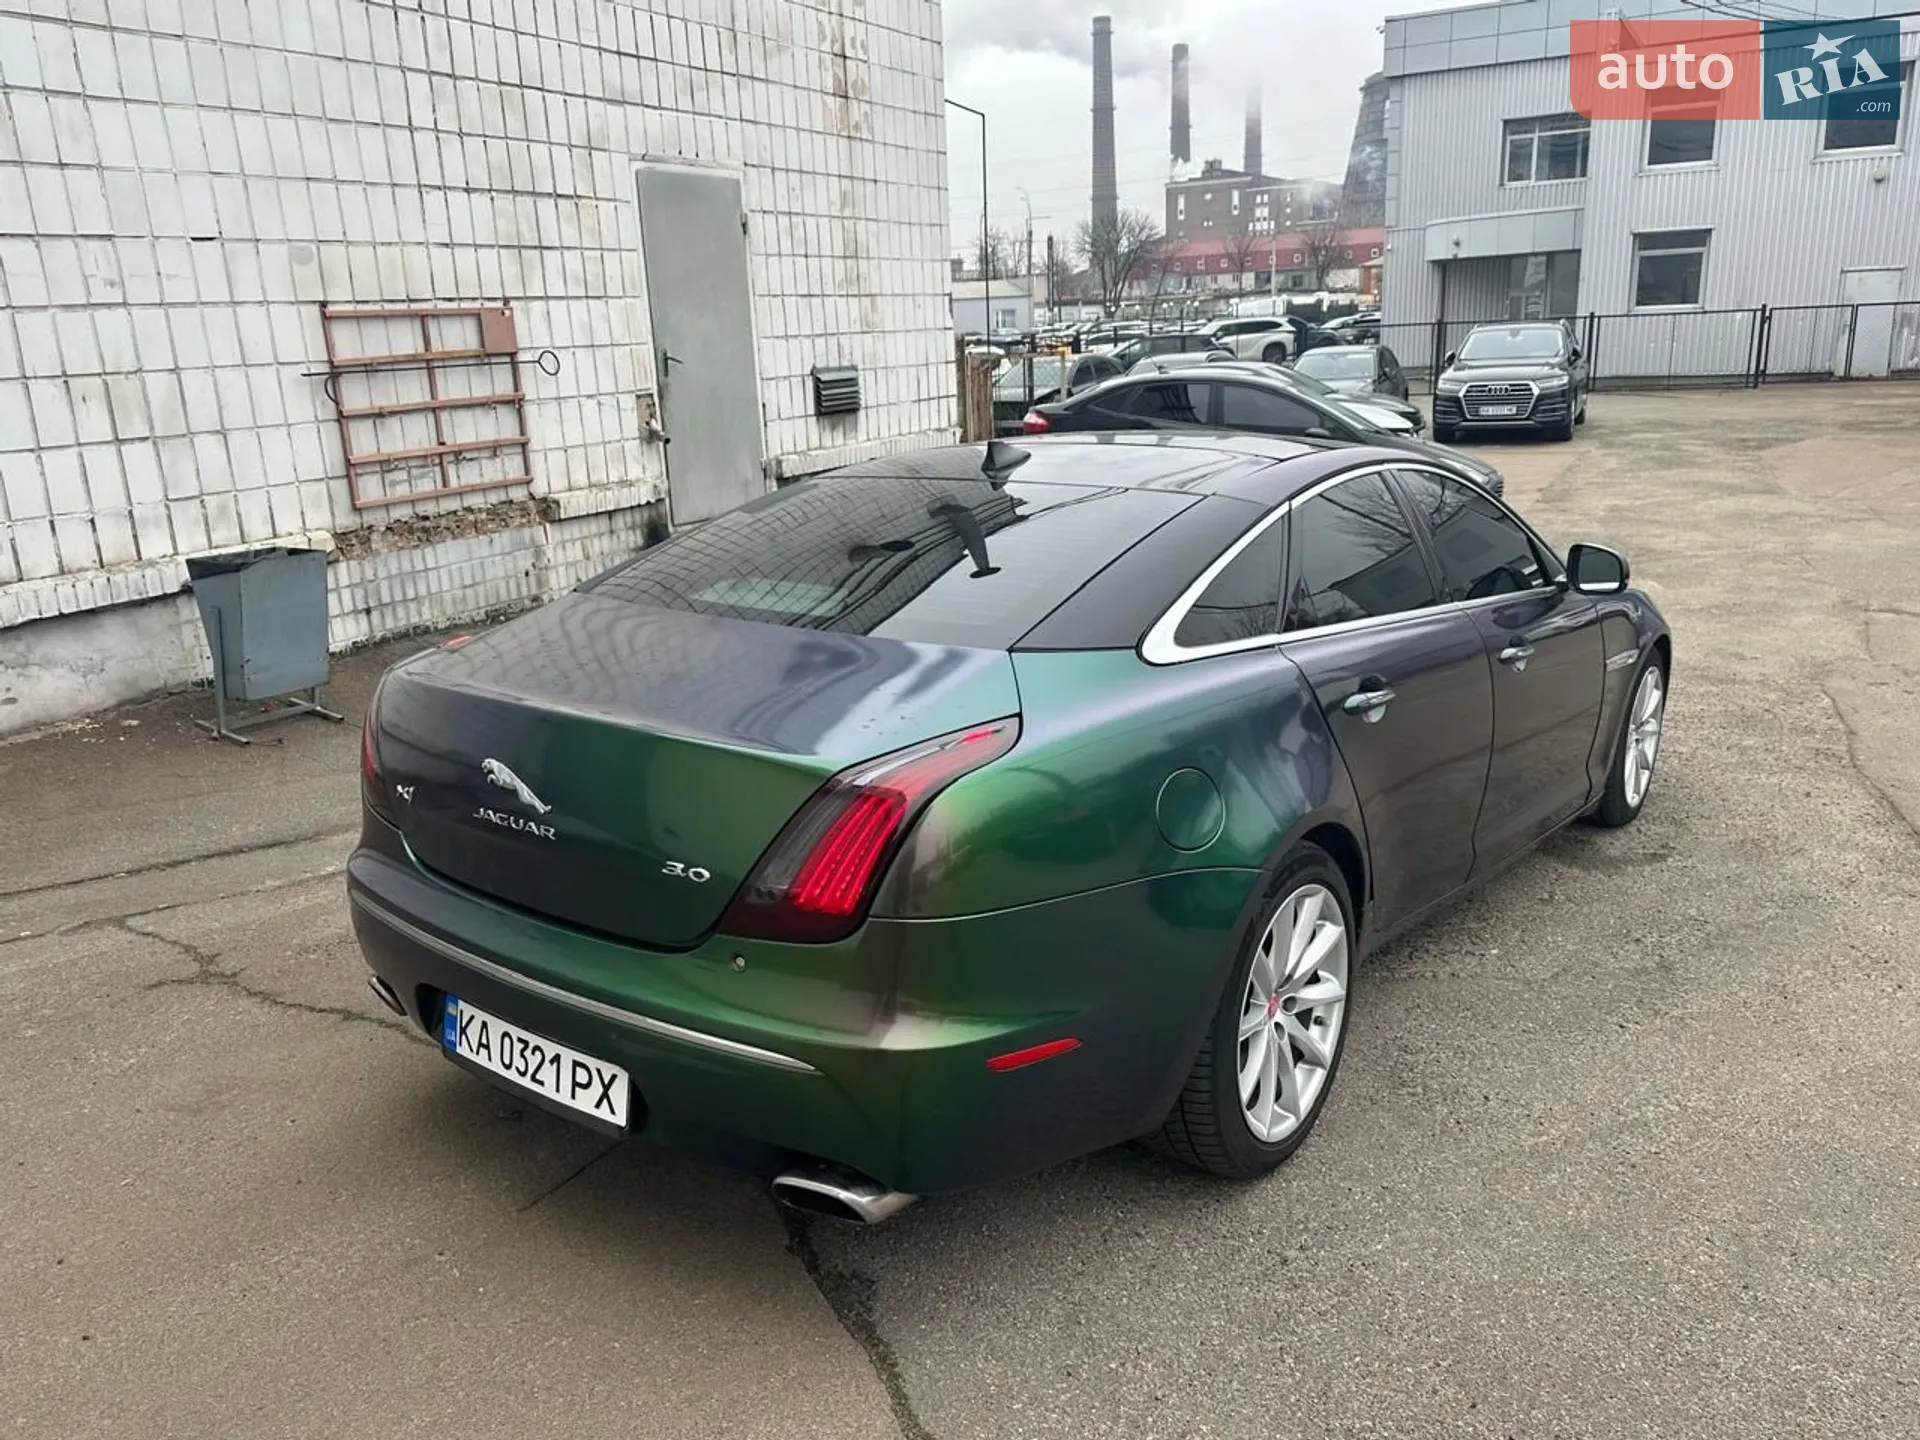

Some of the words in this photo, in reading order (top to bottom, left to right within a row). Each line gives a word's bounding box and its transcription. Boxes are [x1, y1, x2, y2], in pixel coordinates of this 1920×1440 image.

[473, 807, 556, 840] JAGUAR
[661, 860, 711, 883] 3.0
[458, 1009, 493, 1063] KA
[500, 1030, 562, 1095] 0321
[570, 1059, 618, 1117] PX
